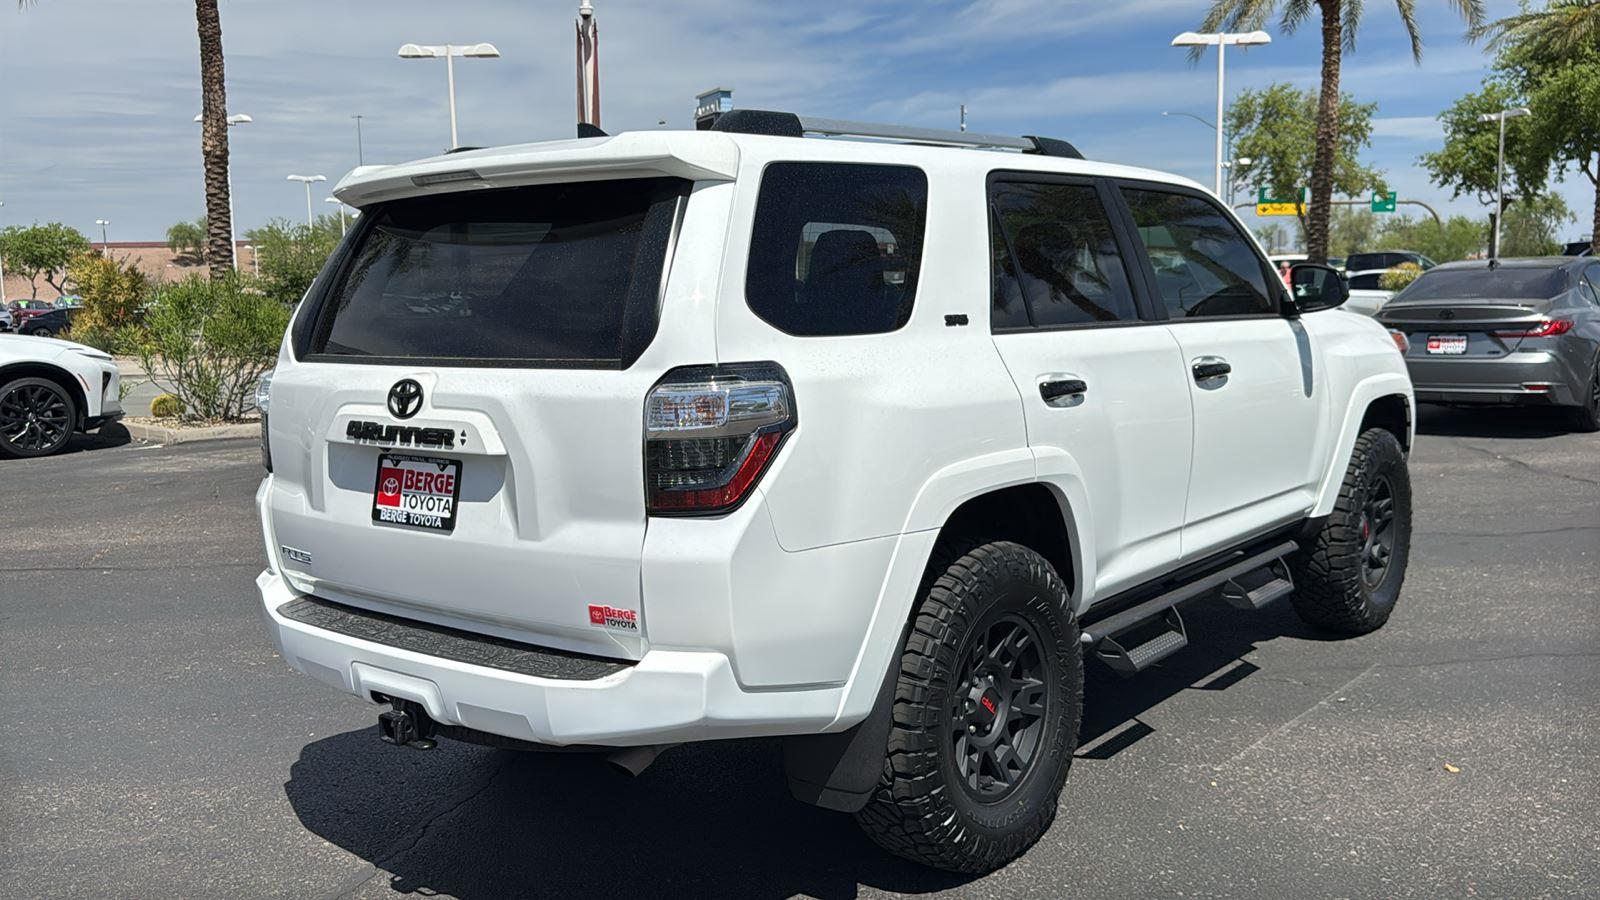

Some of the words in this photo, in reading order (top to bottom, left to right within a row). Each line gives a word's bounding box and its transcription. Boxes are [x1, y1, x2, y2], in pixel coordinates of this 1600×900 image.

[346, 420, 455, 447] 4RUNNER
[403, 469, 454, 494] BERGE
[402, 494, 452, 514] TOYOTA
[380, 508, 408, 523] BERGE
[409, 513, 442, 528] TOYOTA
[605, 618, 638, 630] TOYOTA
